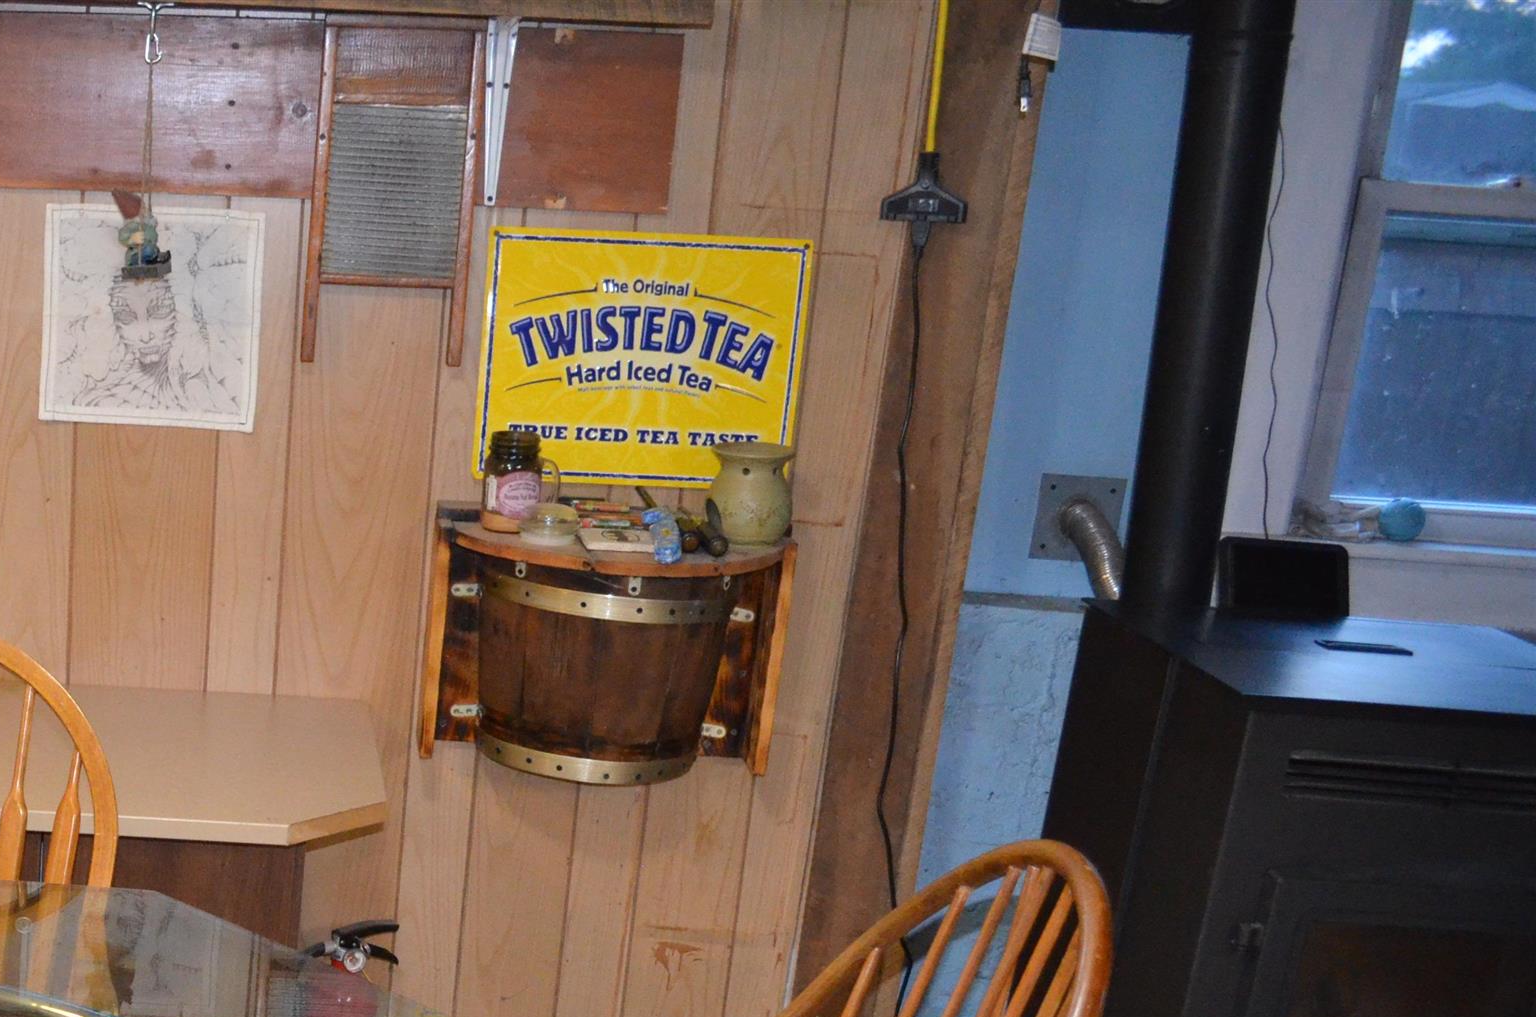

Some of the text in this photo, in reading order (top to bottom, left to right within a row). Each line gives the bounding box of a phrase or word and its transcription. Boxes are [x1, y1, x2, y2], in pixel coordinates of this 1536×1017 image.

[602, 279, 690, 297] The Original
[509, 305, 775, 382] TWISTED TEA
[565, 361, 622, 386] Hard
[627, 360, 672, 384] Iced
[677, 366, 713, 392] Tea
[574, 426, 629, 442] ICED
[636, 429, 680, 445] TEA
[687, 431, 759, 447] TASTE
